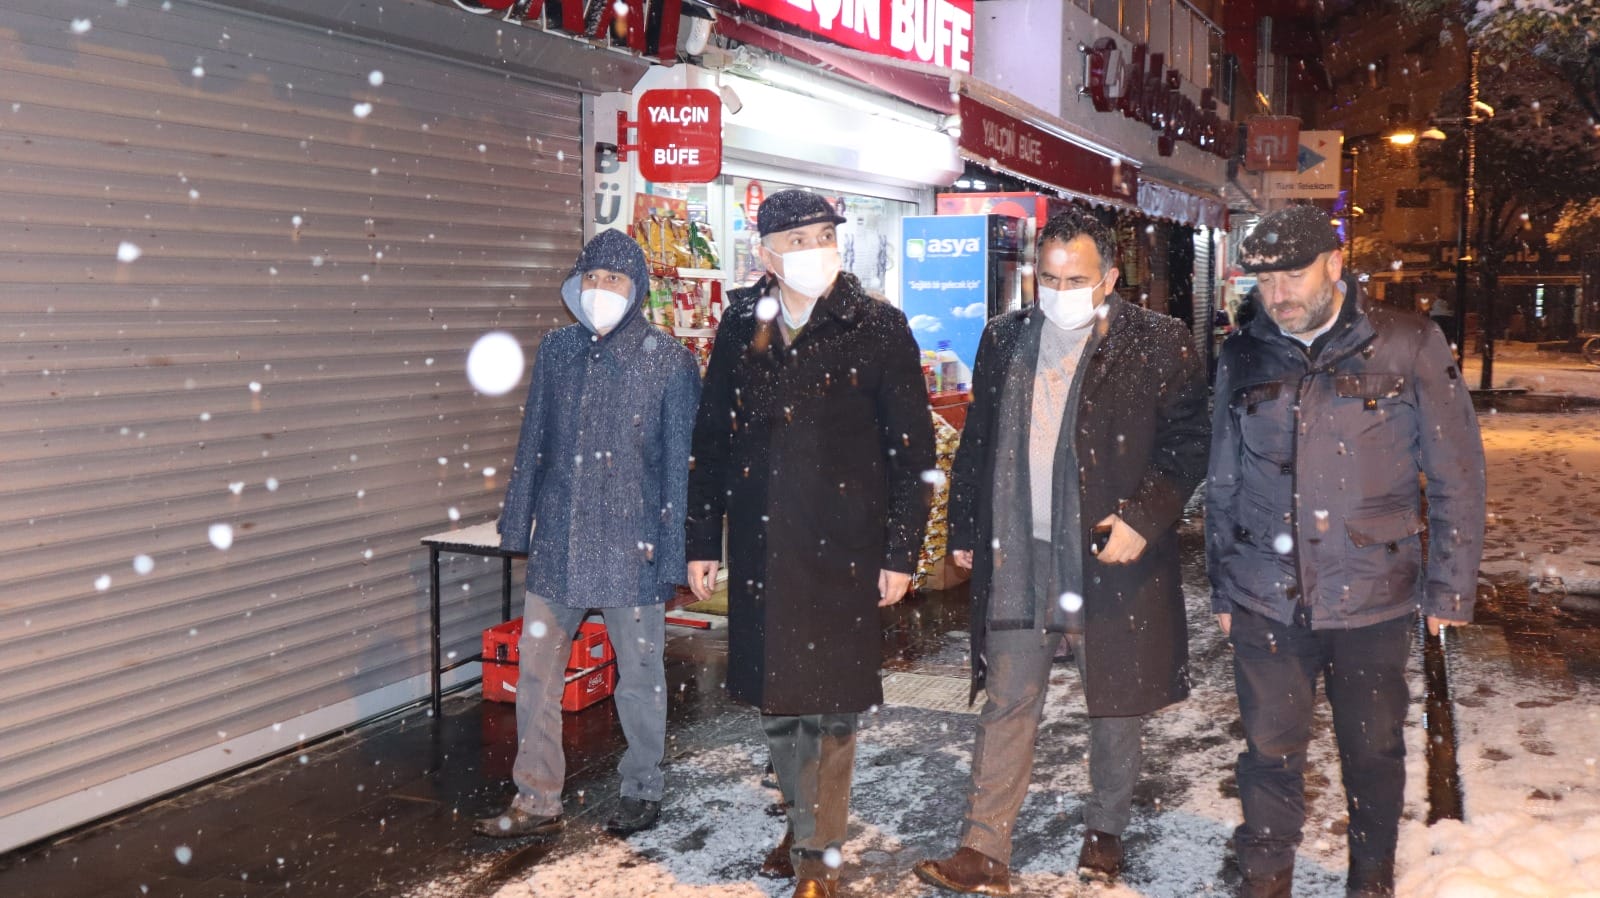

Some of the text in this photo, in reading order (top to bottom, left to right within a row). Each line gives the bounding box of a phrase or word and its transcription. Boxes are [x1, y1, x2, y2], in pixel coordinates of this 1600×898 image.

[648, 106, 709, 127] YALÇIN
[654, 143, 700, 165] BÜFE
[927, 238, 980, 257] asya
